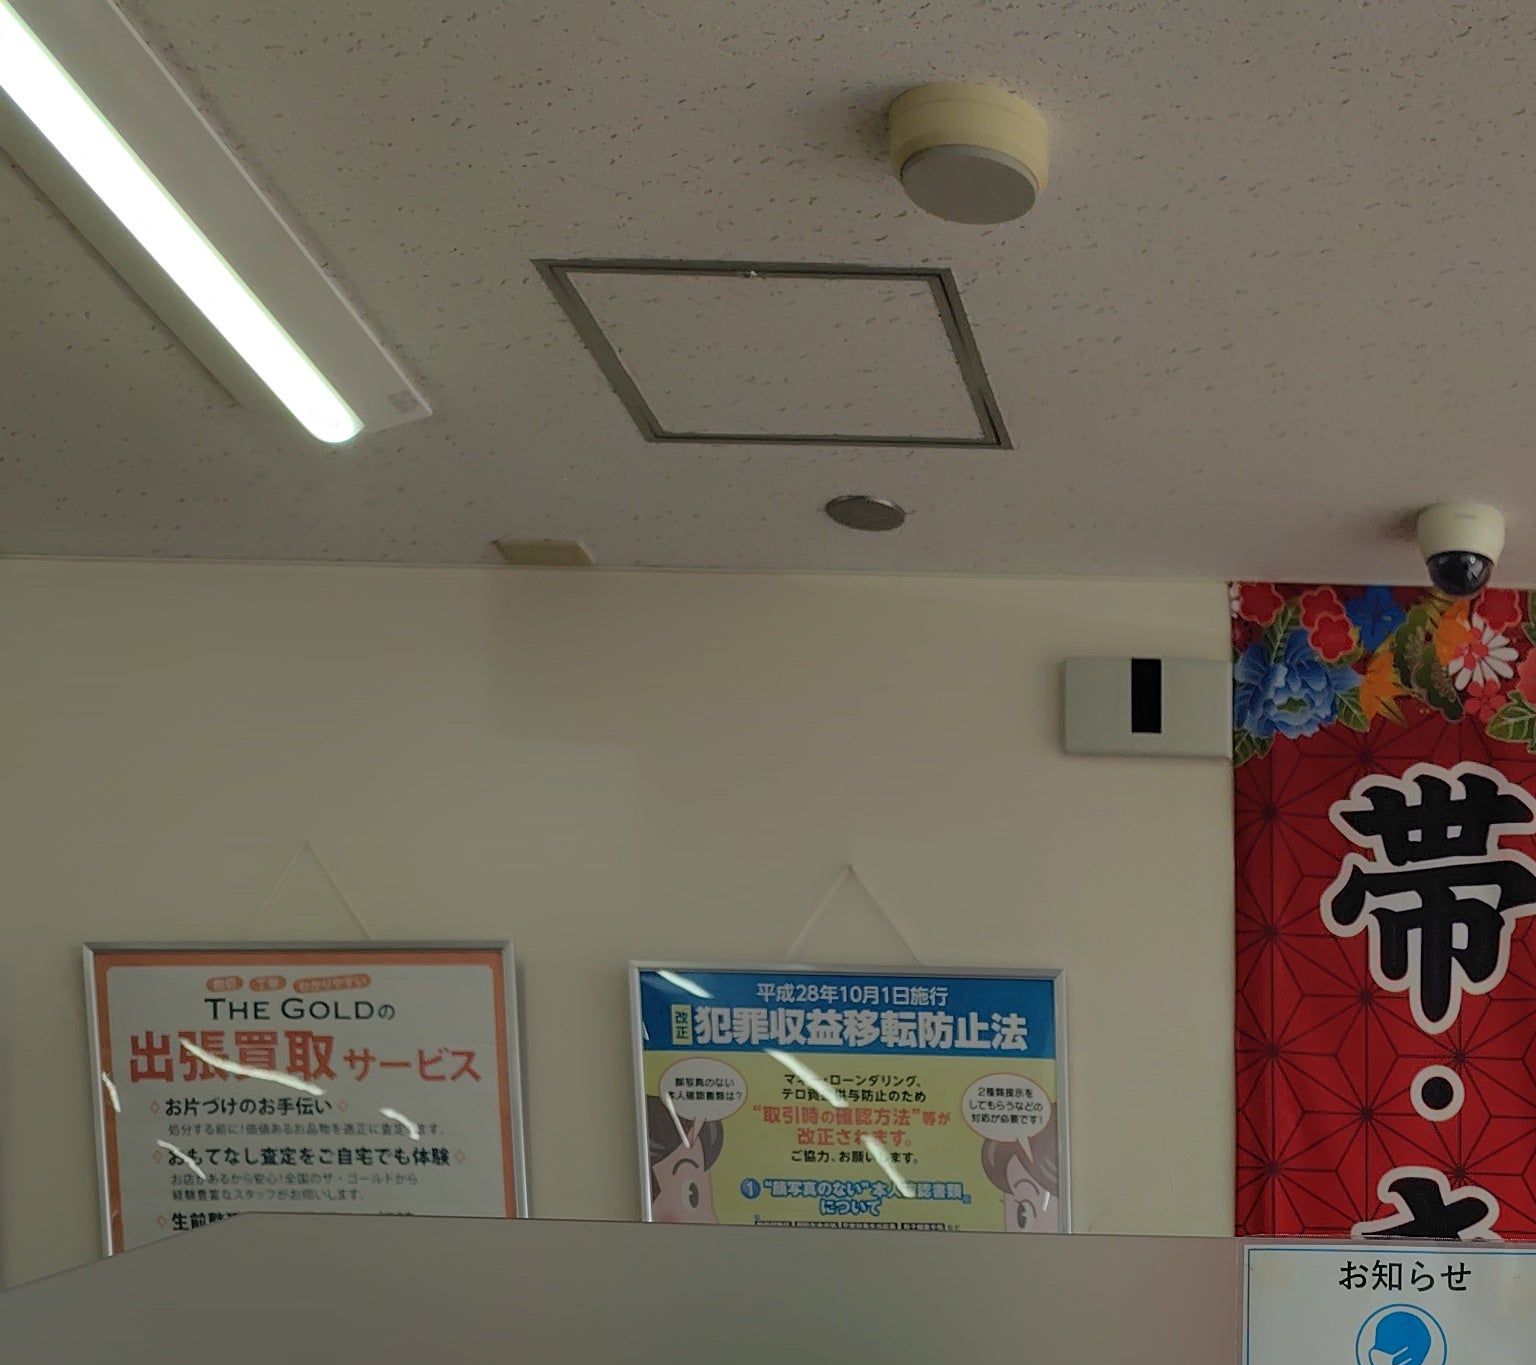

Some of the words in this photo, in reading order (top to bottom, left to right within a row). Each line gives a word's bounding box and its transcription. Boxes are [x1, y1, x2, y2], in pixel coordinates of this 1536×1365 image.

[757, 982, 948, 1007] 平成28年10月1日施行
[204, 998, 270, 1020] THE
[673, 1010, 690, 1041] 改正
[694, 1006, 1028, 1052] 犯罪収益移転防止法
[165, 1097, 333, 1117] お片づけのお手伝い
[167, 1147, 451, 1168] おもてなし査定をご自宅でも体験
[820, 1199, 883, 1216] について
[1338, 1259, 1472, 1292] お知らせ
